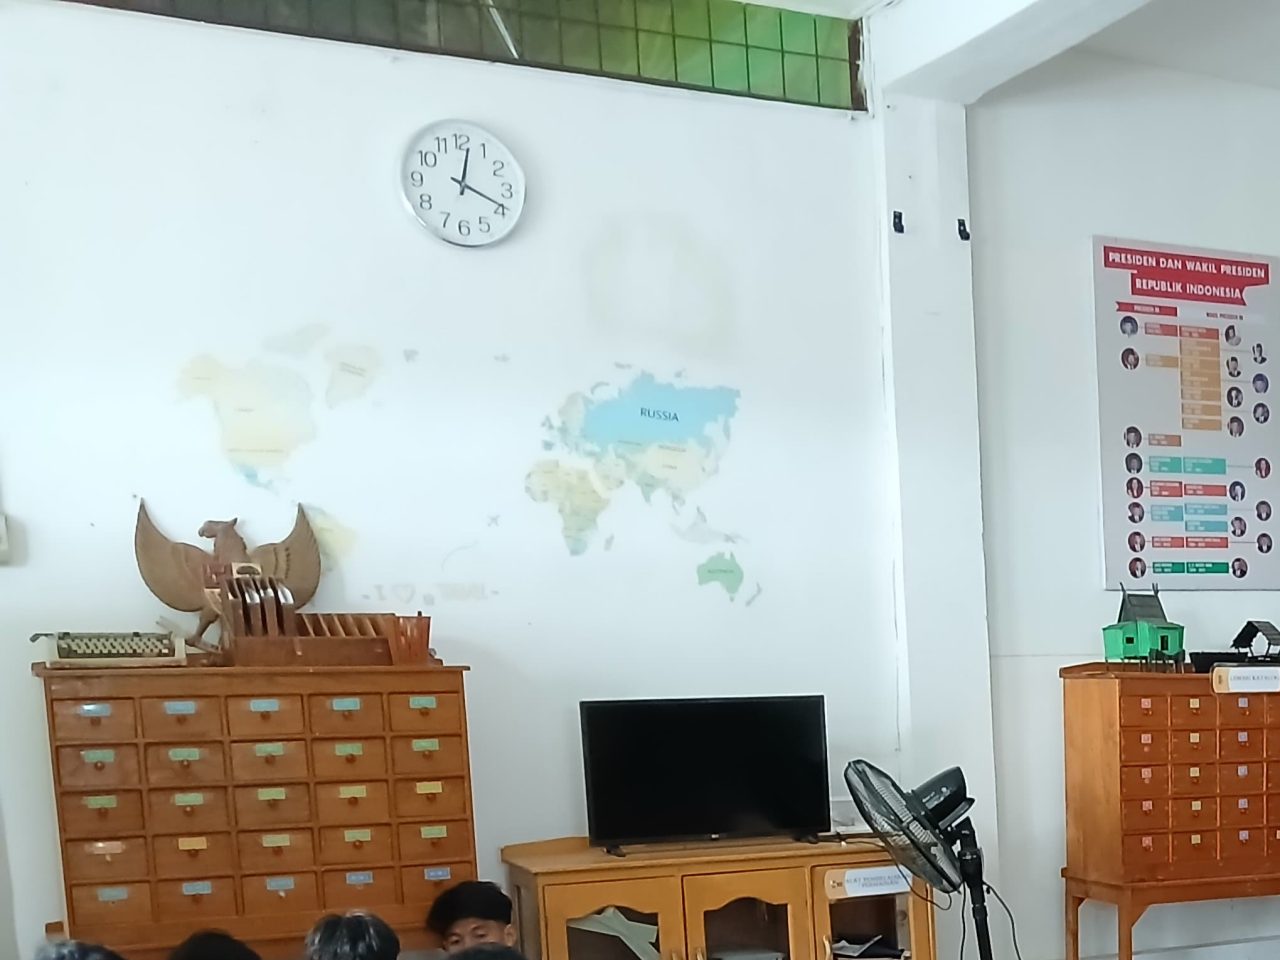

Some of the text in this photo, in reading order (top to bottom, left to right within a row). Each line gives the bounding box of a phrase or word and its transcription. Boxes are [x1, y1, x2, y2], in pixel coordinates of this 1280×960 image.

[434, 137, 447, 154] 11
[452, 133, 470, 151] 12
[418, 150, 437, 168] 10
[480, 143, 486, 159] 1
[493, 160, 504, 177] 2
[410, 170, 423, 187] 9
[501, 182, 513, 199] 3
[419, 193, 432, 210] 8
[493, 203, 506, 218] 4
[440, 211, 451, 228] 7
[458, 219, 471, 236] 6
[478, 216, 491, 233] 5
[1109, 252, 1265, 278] PRESIDEN DAN WAKIL PRESIDEN
[1135, 278, 1241, 299] REPUBLIK INDONESIA
[640, 407, 679, 421] RUSSIA
